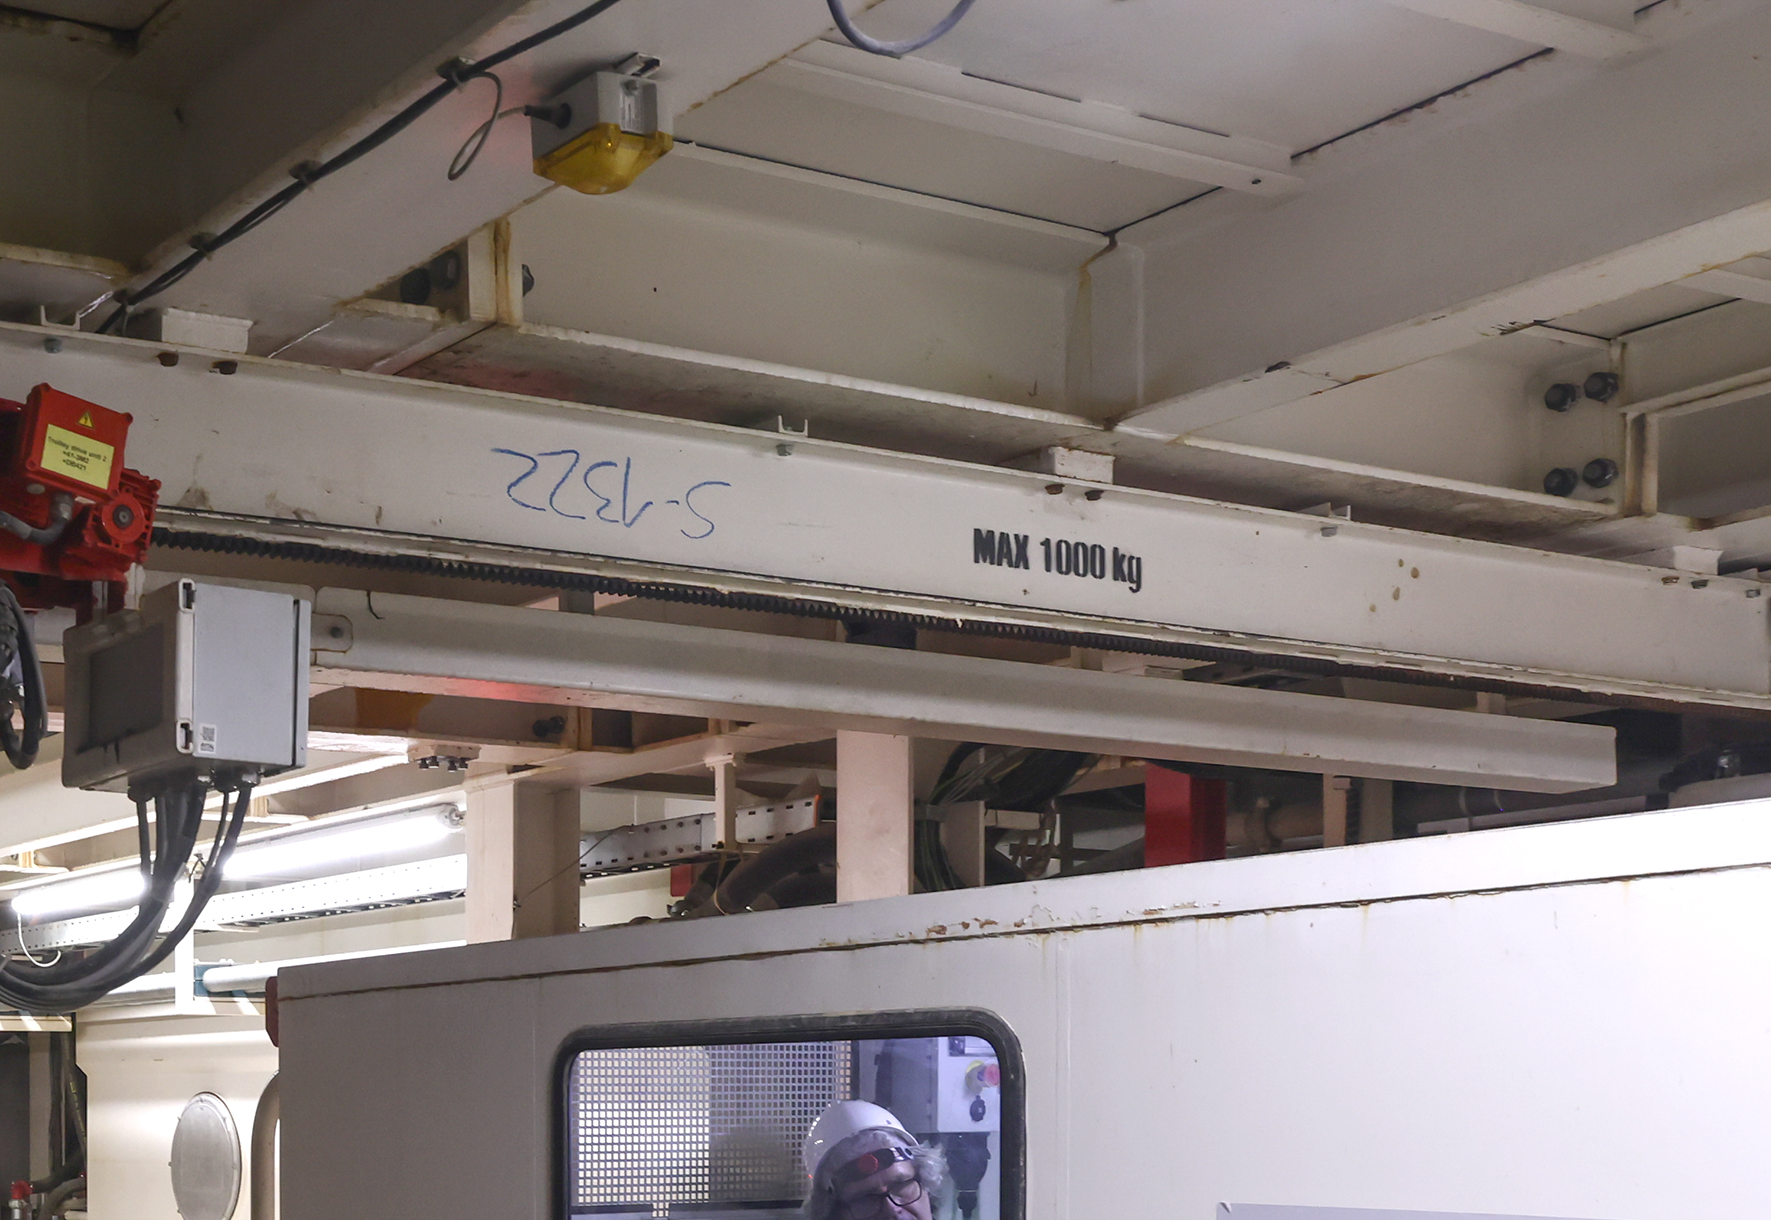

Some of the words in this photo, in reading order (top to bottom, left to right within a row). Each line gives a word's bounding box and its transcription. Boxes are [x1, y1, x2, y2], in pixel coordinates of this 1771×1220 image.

[973, 528, 1030, 570] MAX
[1039, 537, 1106, 580] 1000
[1112, 546, 1142, 593] kg
